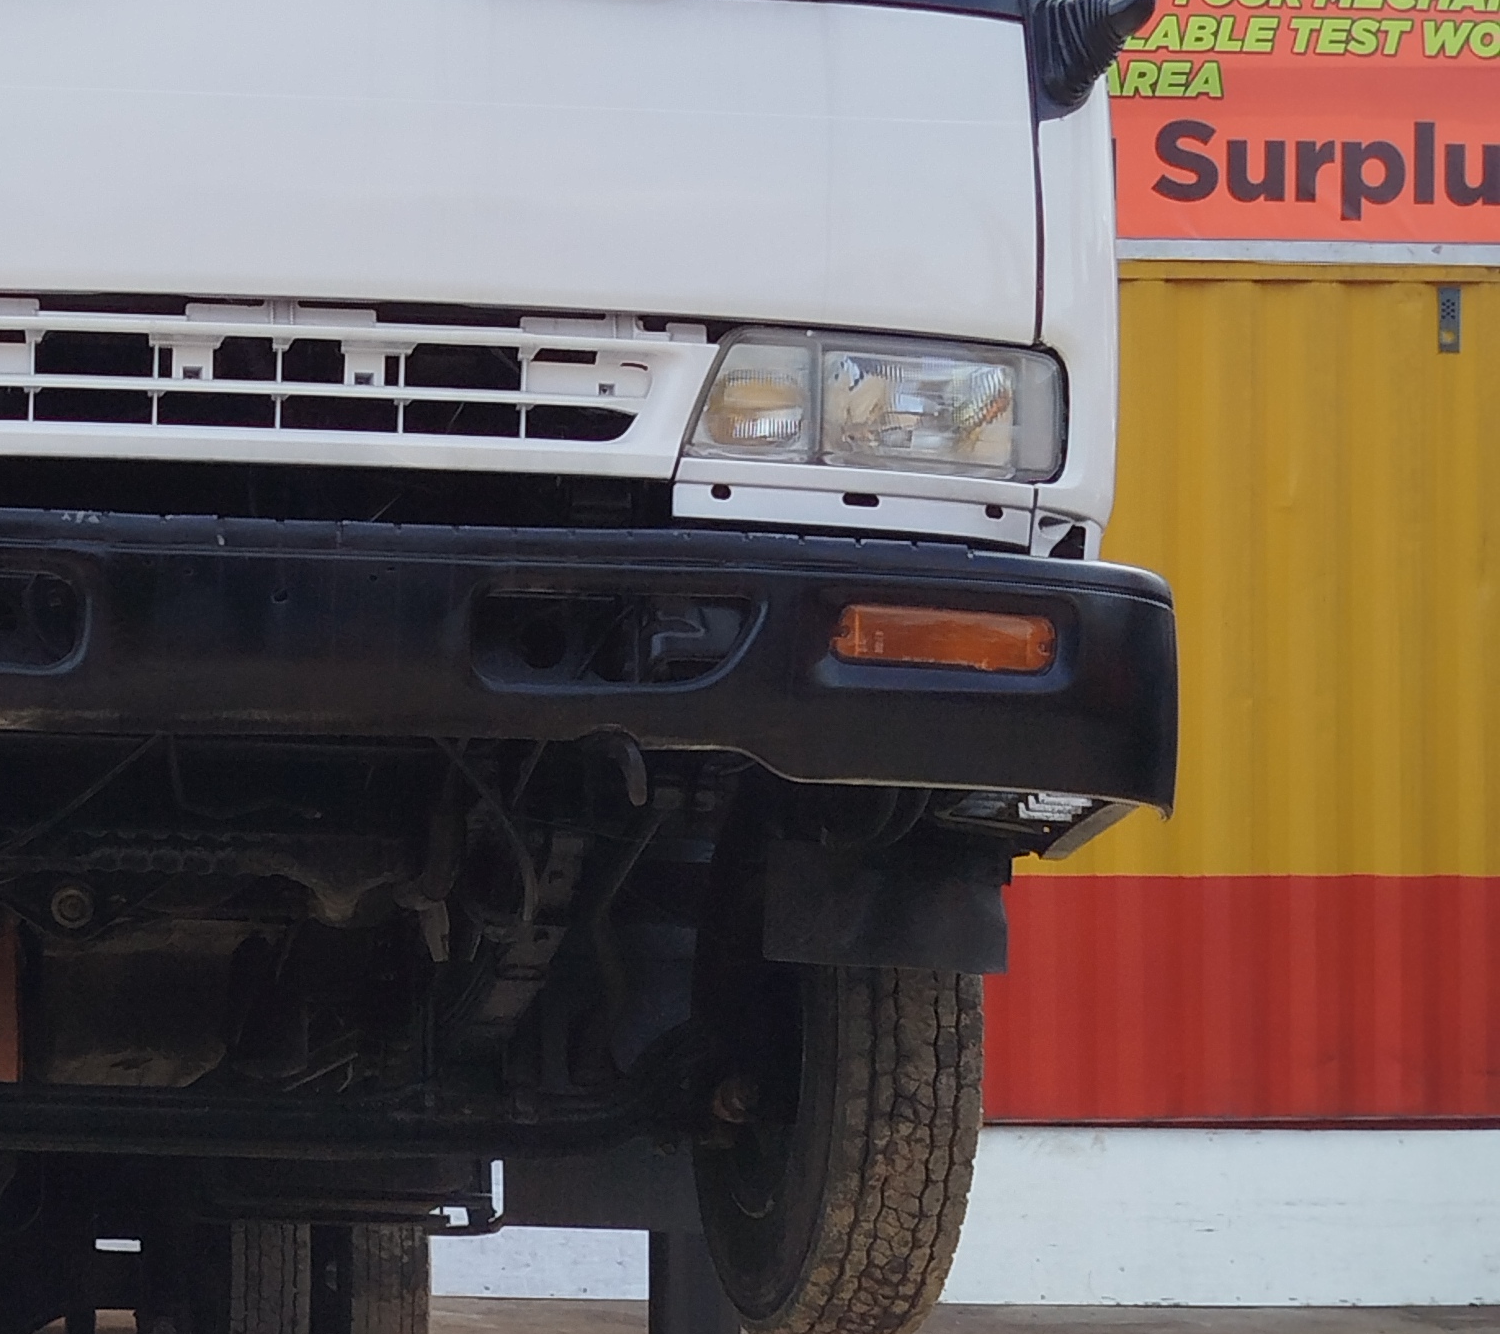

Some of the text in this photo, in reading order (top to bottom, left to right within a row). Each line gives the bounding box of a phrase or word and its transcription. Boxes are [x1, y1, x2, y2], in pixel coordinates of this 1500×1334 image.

[1289, 17, 1413, 56] TEST
[1423, 20, 1500, 59] WO
[1151, 119, 1500, 221] Surplu
